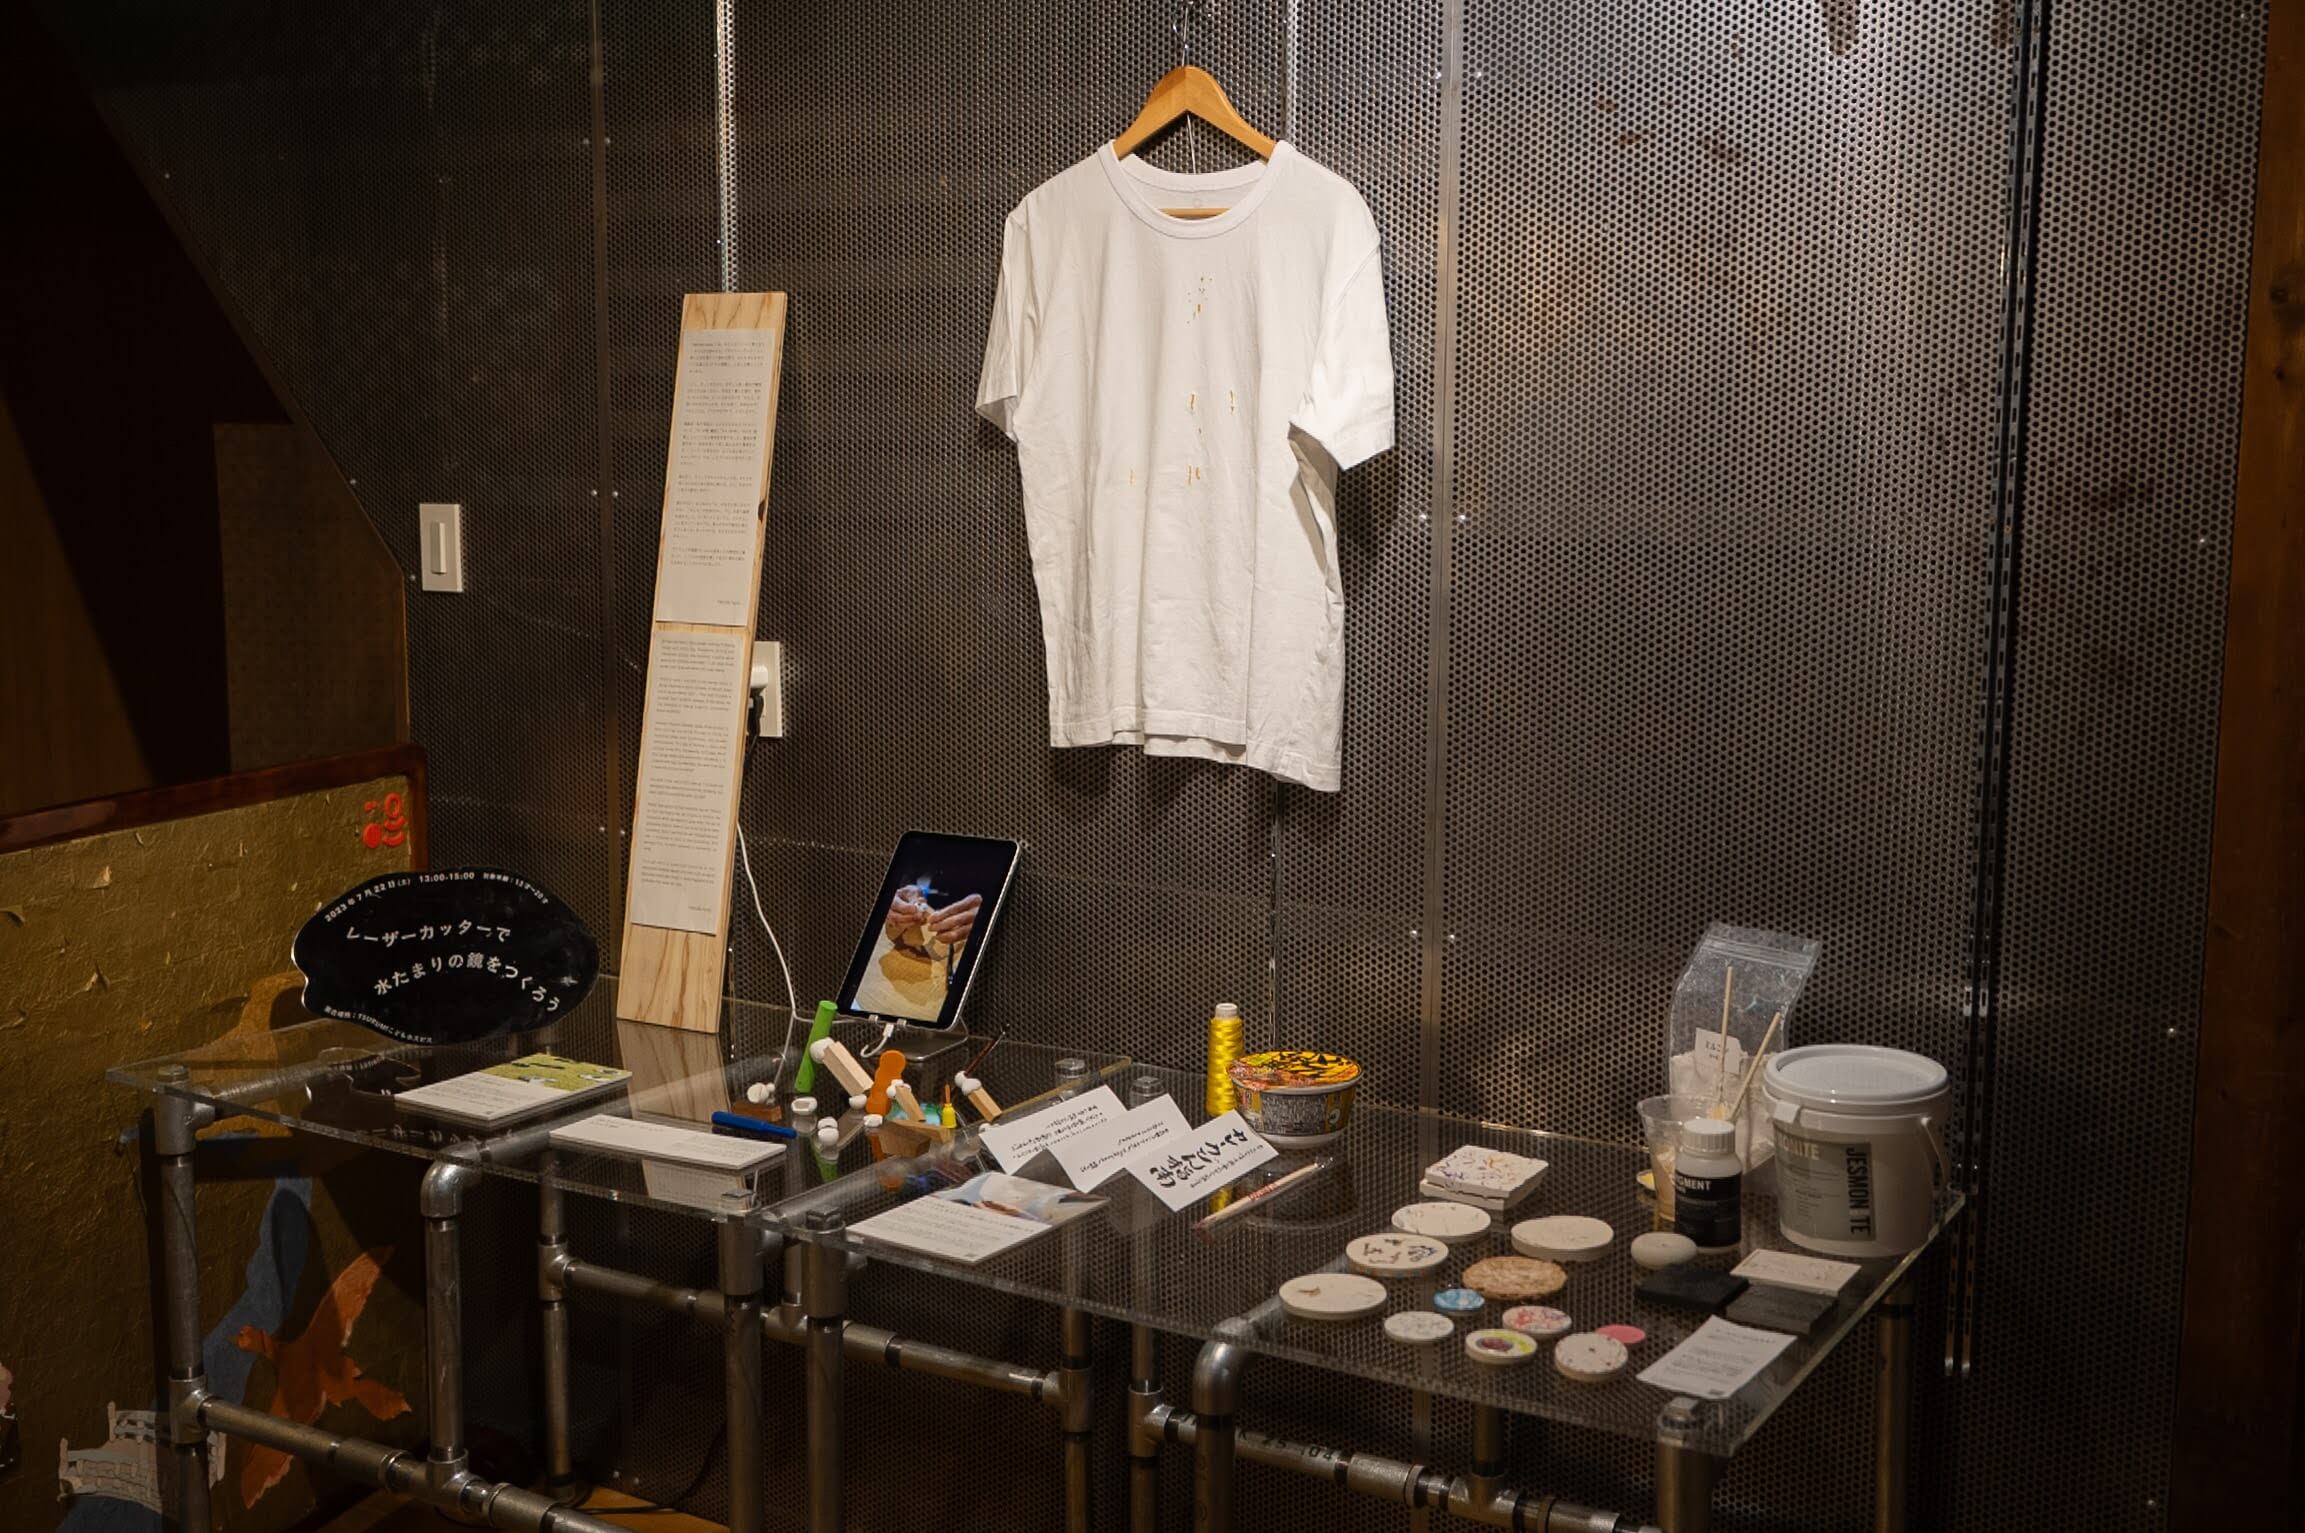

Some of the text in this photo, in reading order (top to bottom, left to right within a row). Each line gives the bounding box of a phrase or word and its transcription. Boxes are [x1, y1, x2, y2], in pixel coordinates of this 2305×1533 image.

[346, 919, 511, 948] レーザーカッターで
[374, 952, 560, 1012] 水たまりの鏡をつくろう
